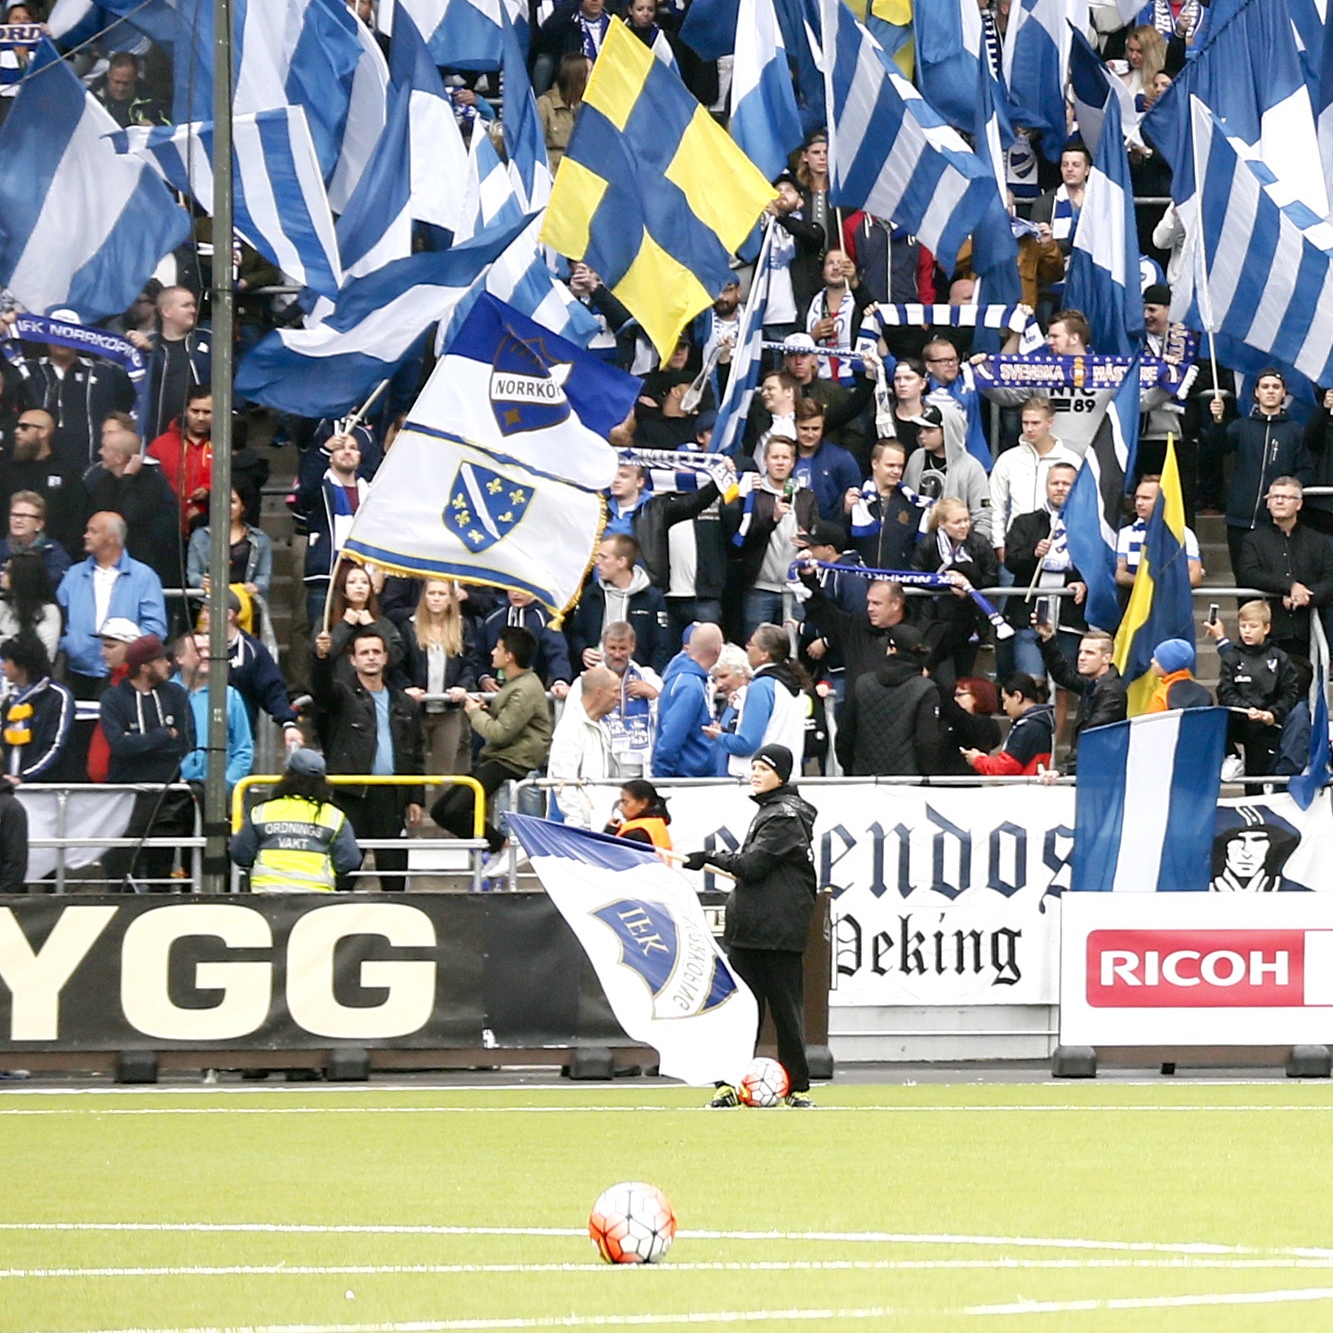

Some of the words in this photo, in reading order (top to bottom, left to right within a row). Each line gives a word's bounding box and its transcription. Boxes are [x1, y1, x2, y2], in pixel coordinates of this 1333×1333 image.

[17, 319, 43, 334] IFK
[999, 364, 1064, 382] SVENSKA
[1092, 362, 1158, 383] MÄSTRE
[1072, 398, 1096, 414] 89
[264, 822, 324, 838] ORDNINGS
[278, 837, 309, 851] VAKT
[834, 912, 1022, 986] Peking
[0, 903, 437, 1041] YGG
[1100, 949, 1289, 987] RICOH
